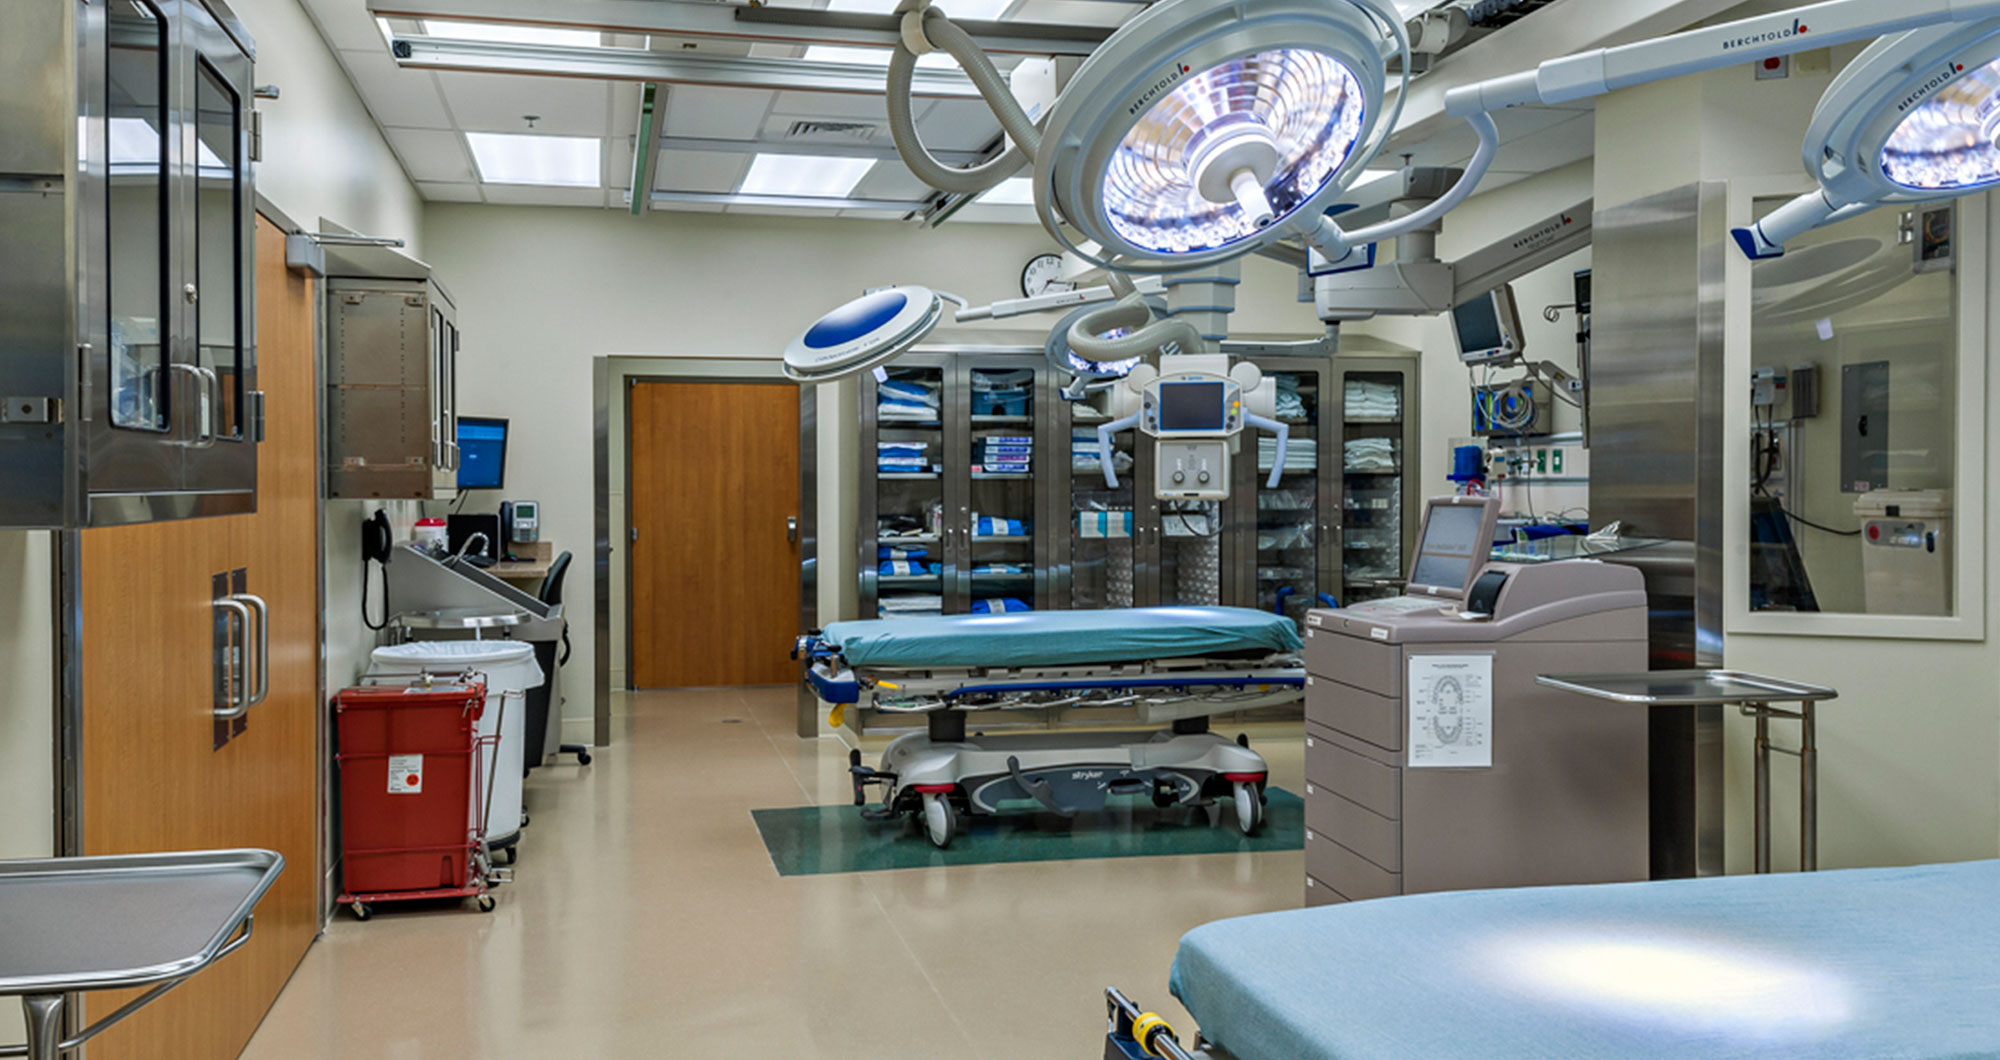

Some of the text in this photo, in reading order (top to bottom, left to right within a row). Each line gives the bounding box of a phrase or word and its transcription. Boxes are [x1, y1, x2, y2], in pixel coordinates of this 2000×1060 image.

[1722, 28, 1791, 50] BERCHTOLD
[1129, 72, 1178, 115] BERCHTOLD
[1897, 71, 1951, 111] BERCHTOLD
[1071, 769, 1103, 780] stryker
